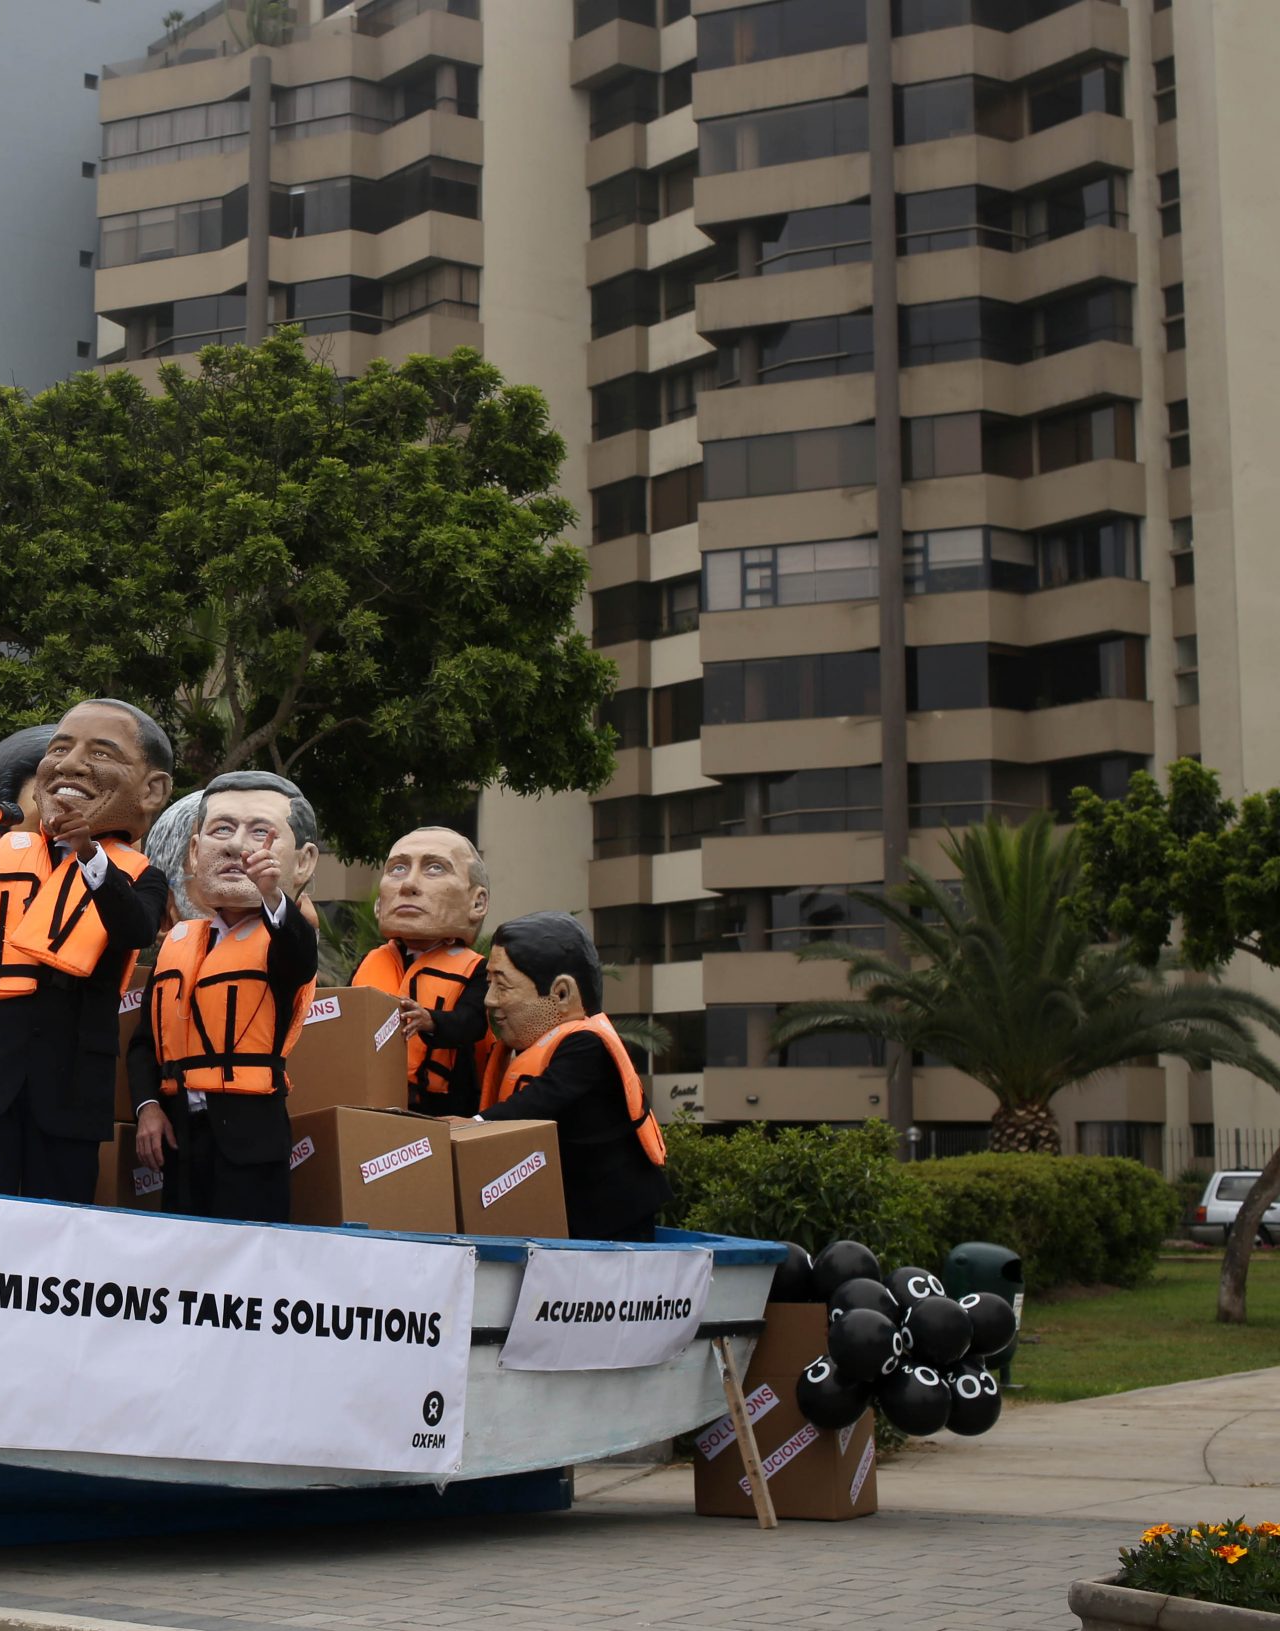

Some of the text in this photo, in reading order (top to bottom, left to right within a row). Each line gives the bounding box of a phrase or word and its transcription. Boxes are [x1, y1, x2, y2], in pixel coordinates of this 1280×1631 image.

[360, 1139, 430, 1179] SOLUCIONES
[484, 1154, 542, 1204] SOLUTIONS
[178, 1290, 263, 1331] TAKE
[271, 1298, 442, 1348] SOLUTIONS
[535, 1295, 692, 1323] ACUERDO CLIMÁTICO
[411, 1432, 446, 1449] OXFAM
[699, 1387, 775, 1455] SOLUONS
[741, 1424, 817, 1491] SUCIONES
